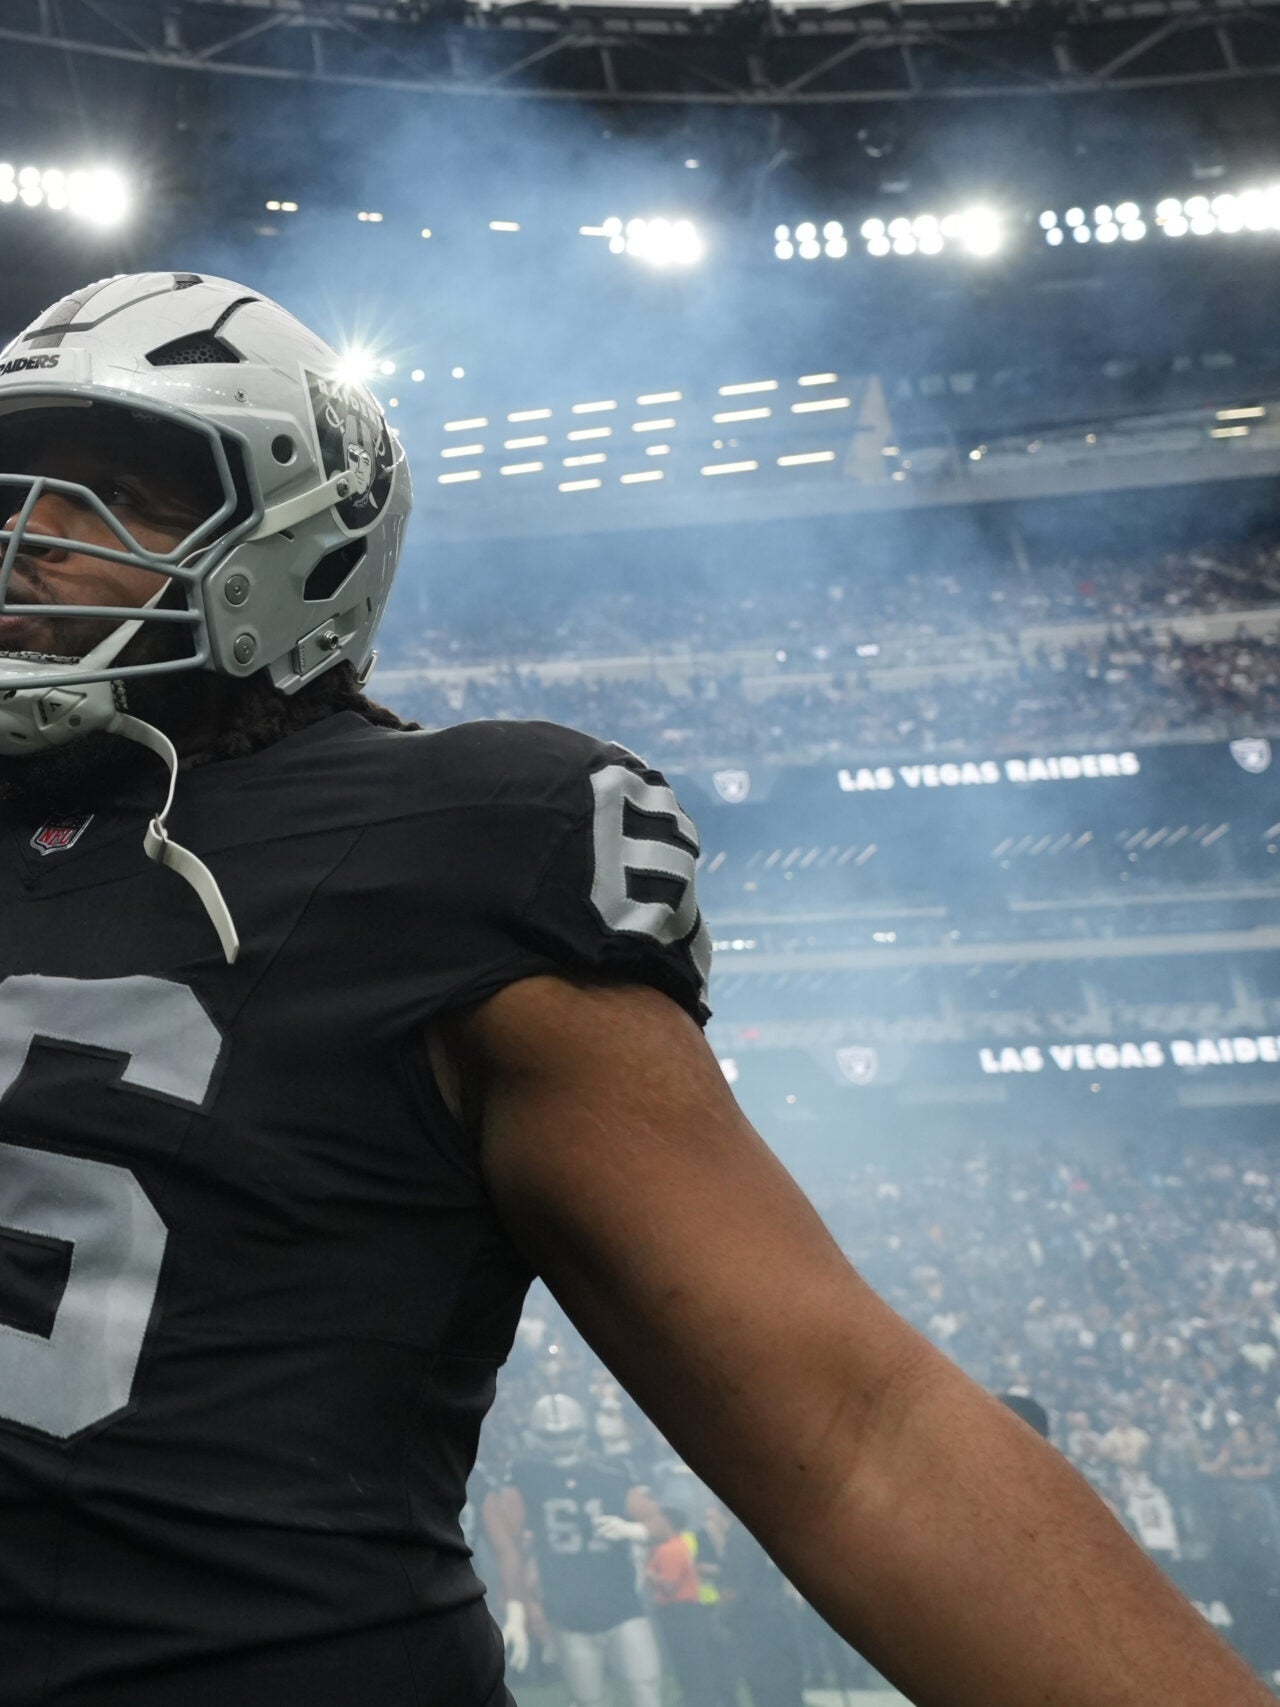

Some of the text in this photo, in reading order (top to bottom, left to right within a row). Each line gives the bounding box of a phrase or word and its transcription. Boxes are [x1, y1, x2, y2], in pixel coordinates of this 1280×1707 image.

[837, 751, 1140, 792] LAS VEGAS RAIDERS
[979, 1035, 1280, 1073] LAS VEGAS RAIDE
